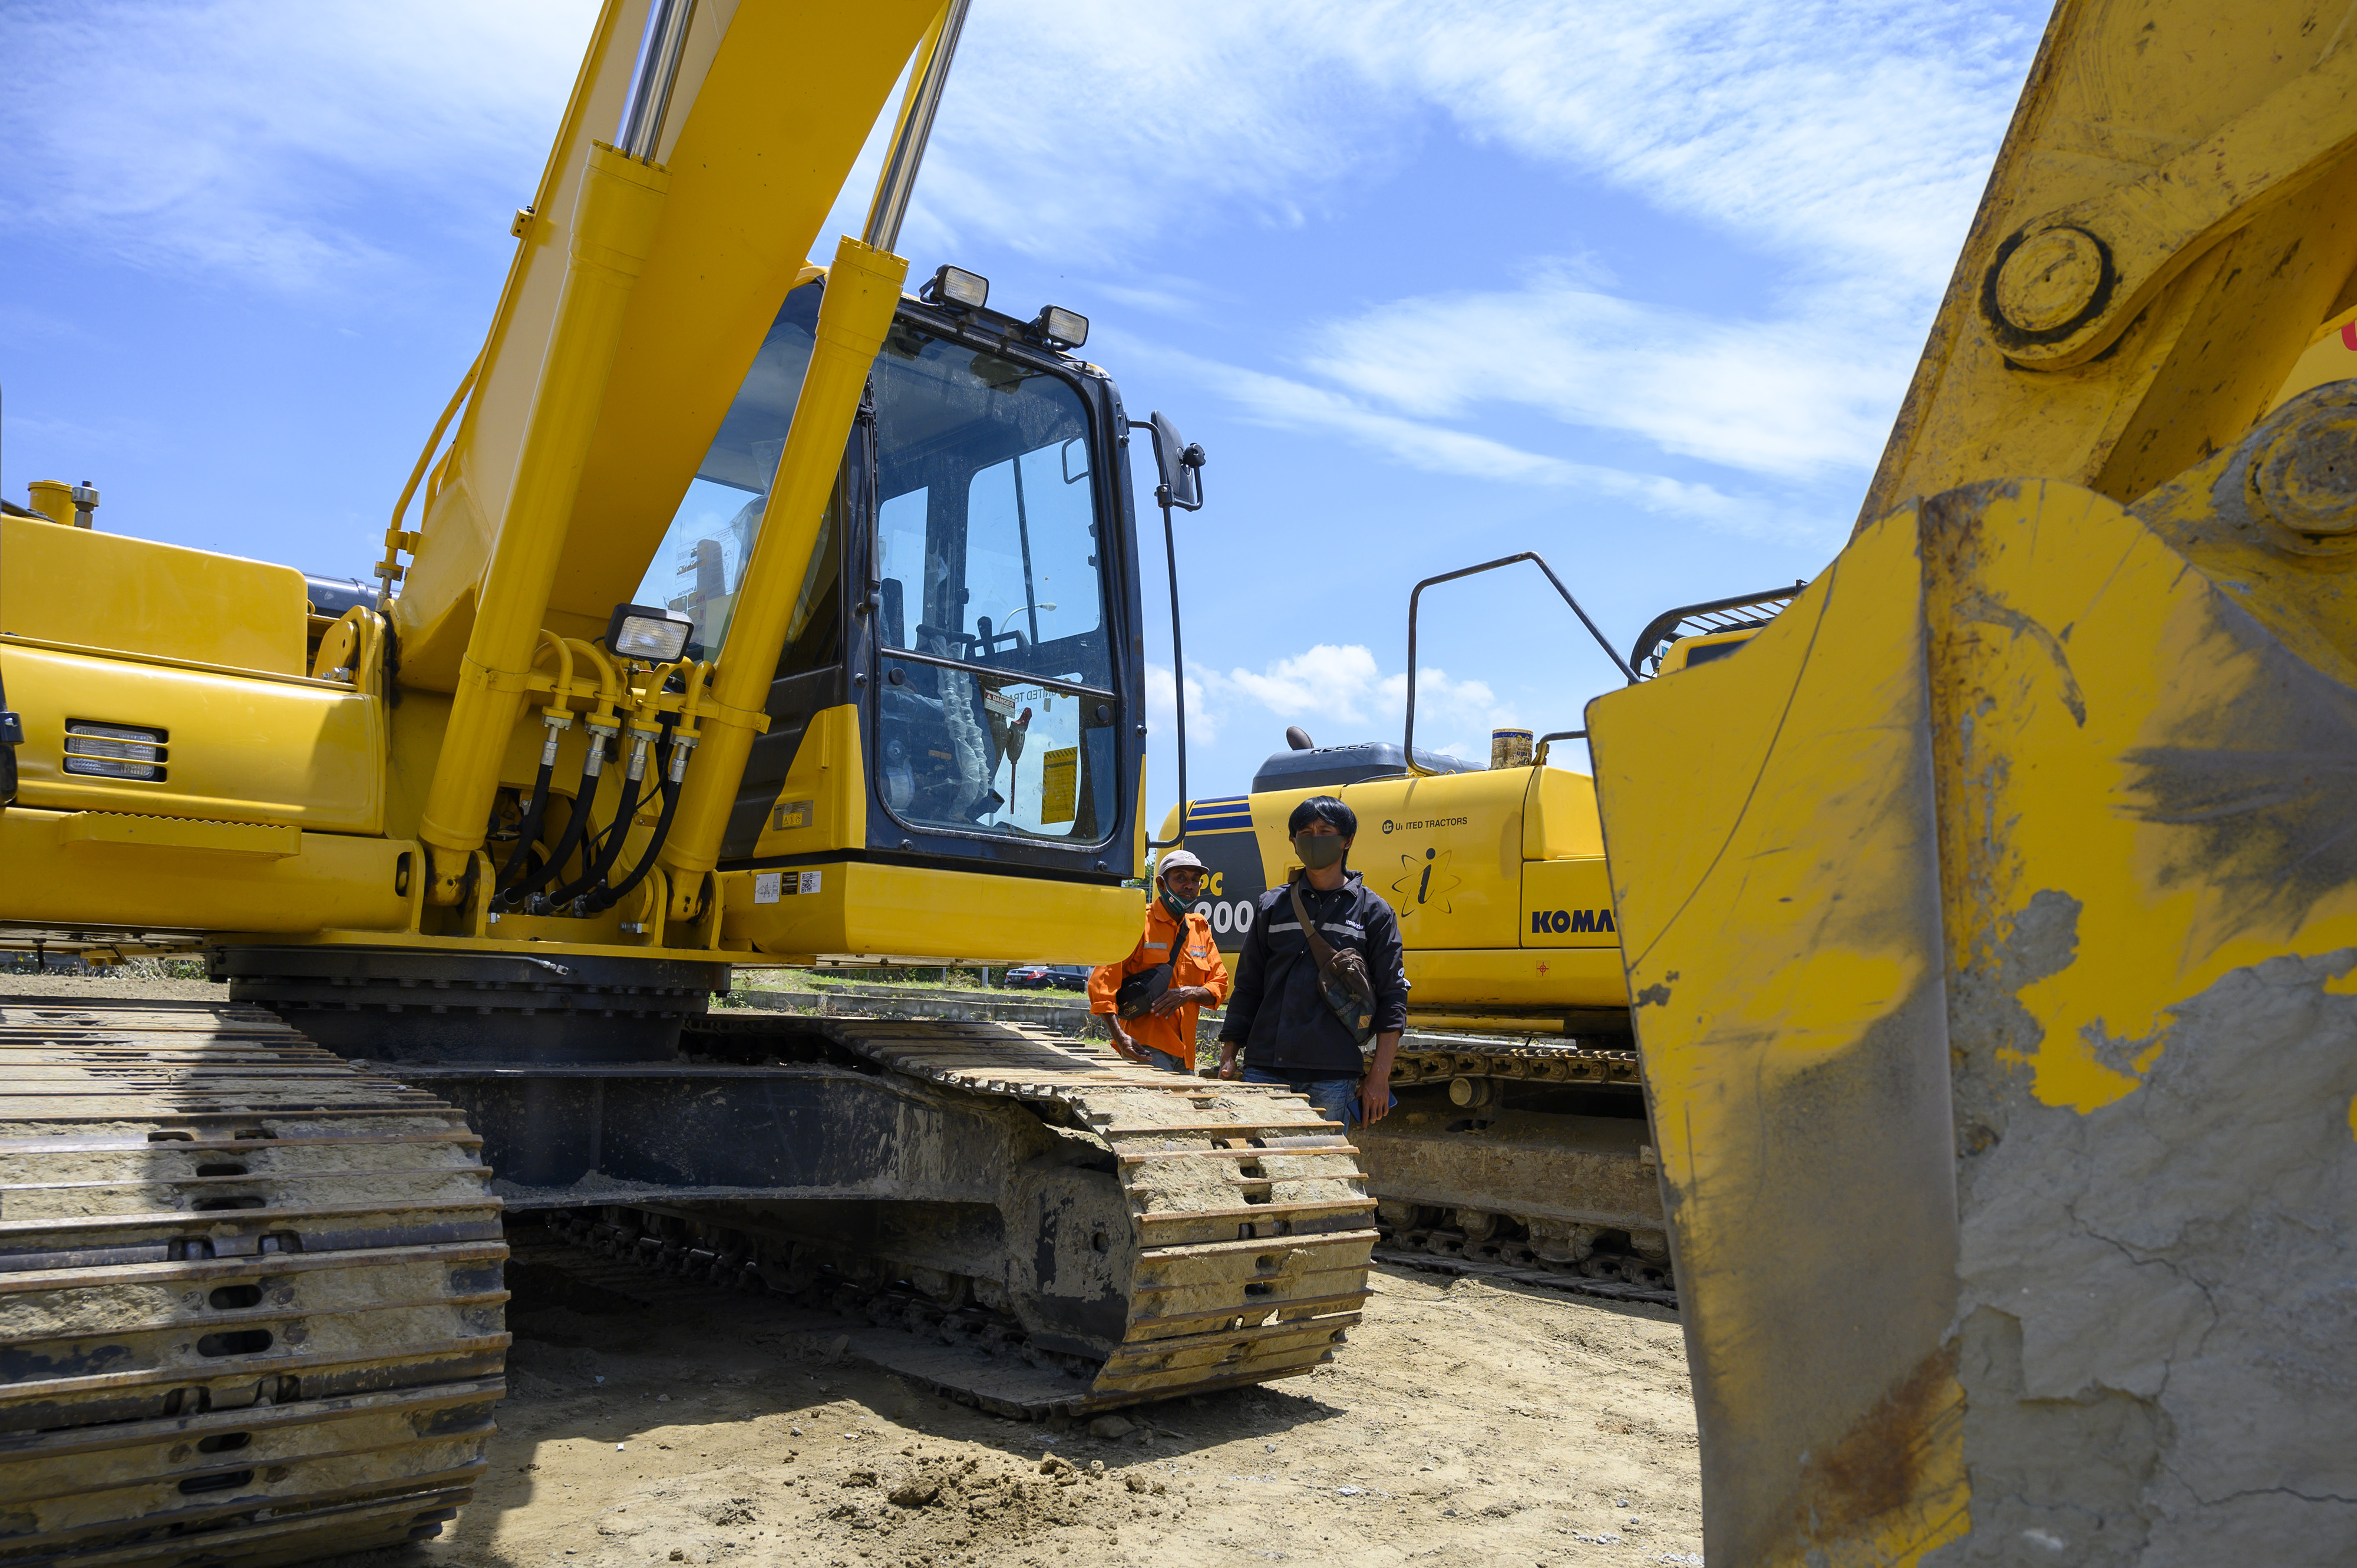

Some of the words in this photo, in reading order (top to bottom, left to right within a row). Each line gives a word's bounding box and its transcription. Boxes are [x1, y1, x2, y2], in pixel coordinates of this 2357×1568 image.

[992, 695, 1014, 708] DANGER
[1395, 821, 1423, 830] UITED
[1425, 817, 1467, 828] TRACTORS
[1532, 909, 1616, 933] KOMA
